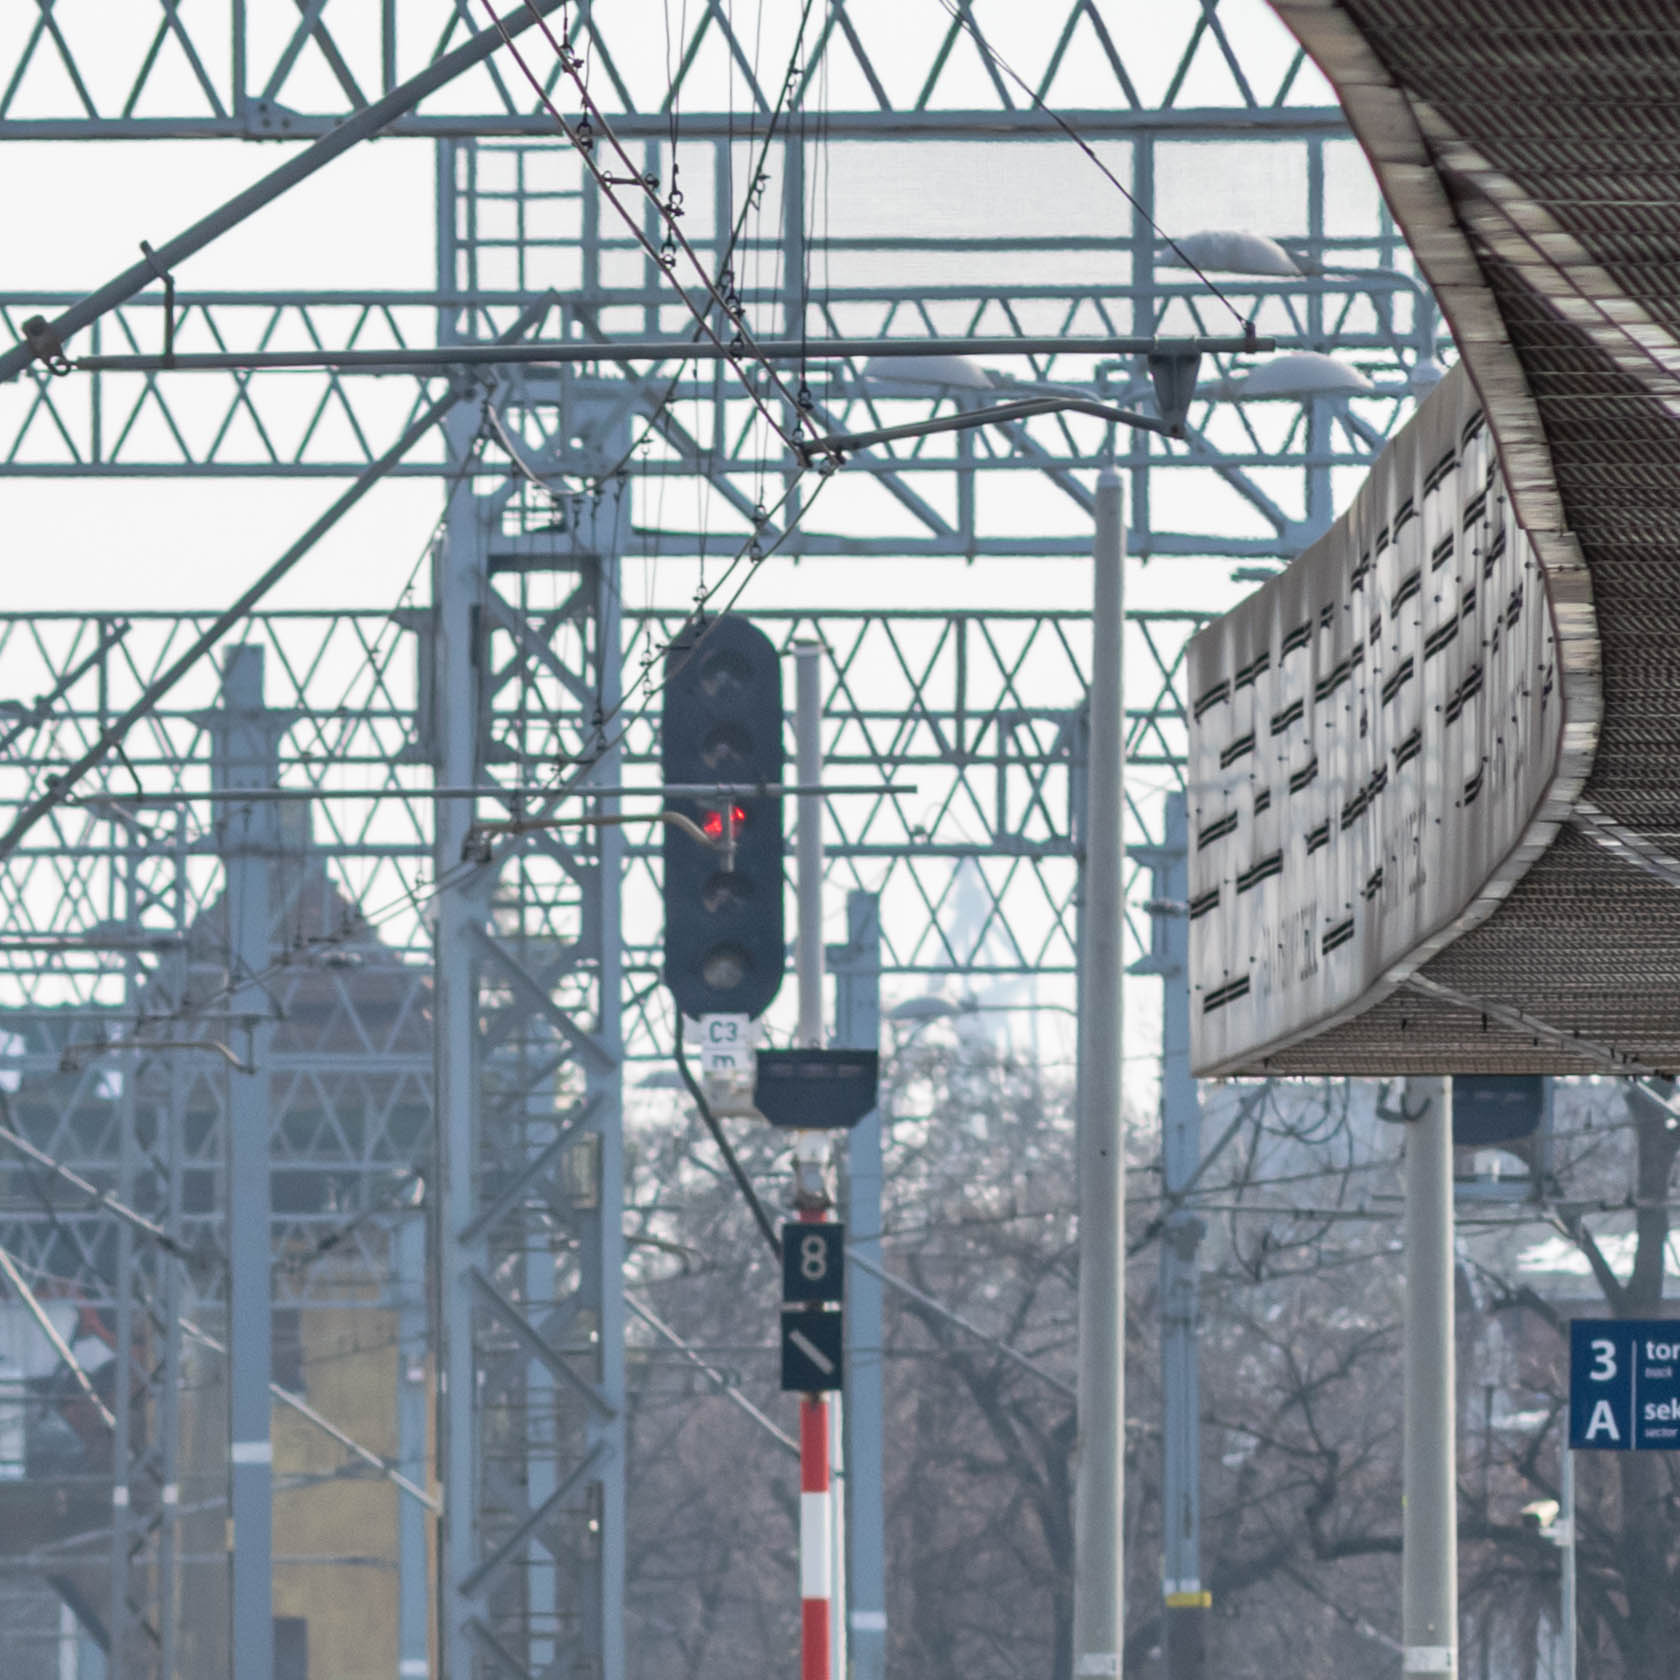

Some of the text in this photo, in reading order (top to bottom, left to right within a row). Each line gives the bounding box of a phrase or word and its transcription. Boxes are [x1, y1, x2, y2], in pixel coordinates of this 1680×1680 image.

[709, 1020, 737, 1043] C3
[800, 1234, 827, 1280] 8
[1589, 1339, 1617, 1381] 3
[1584, 1400, 1621, 1440] A
